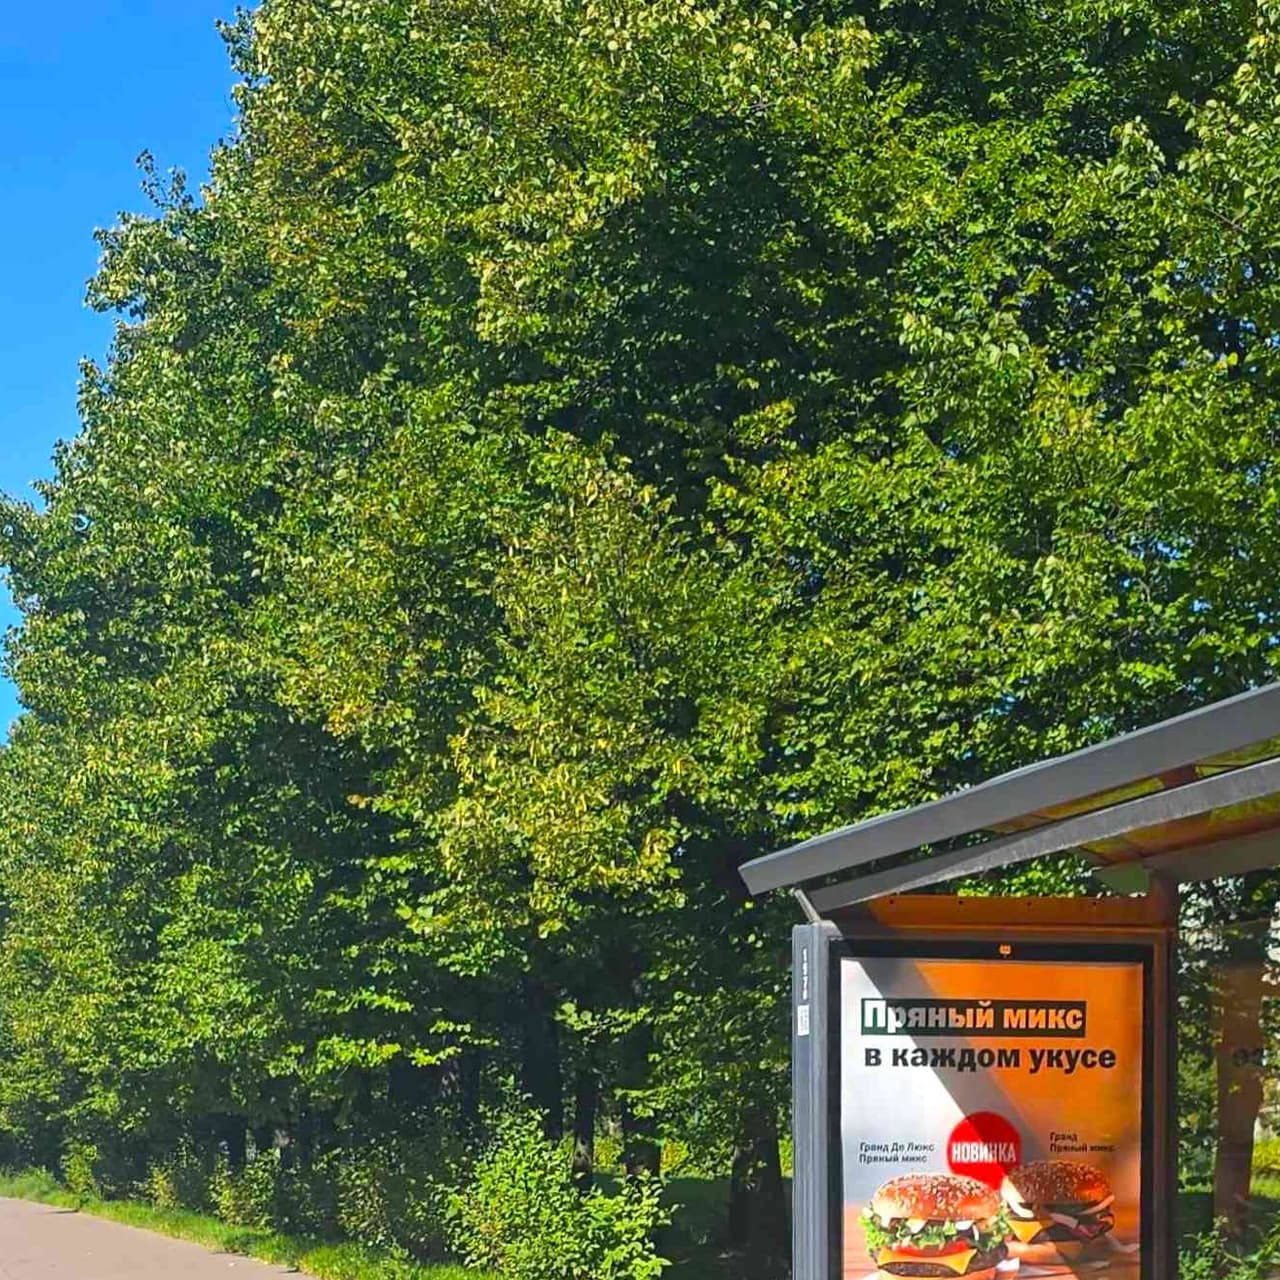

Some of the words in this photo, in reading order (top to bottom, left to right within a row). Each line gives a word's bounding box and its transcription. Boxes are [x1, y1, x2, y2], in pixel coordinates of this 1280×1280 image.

[864, 1000, 994, 1033] Пряный
[1003, 1007, 1083, 1030] микс
[864, 1048, 882, 1067] в
[892, 1047, 1020, 1072] каждом
[1029, 1049, 1117, 1074] укусе
[859, 1153, 899, 1164] Пряный
[901, 1153, 928, 1163] микс
[860, 1142, 889, 1153] Гранд
[951, 1142, 1017, 1164] НОВИНКА
